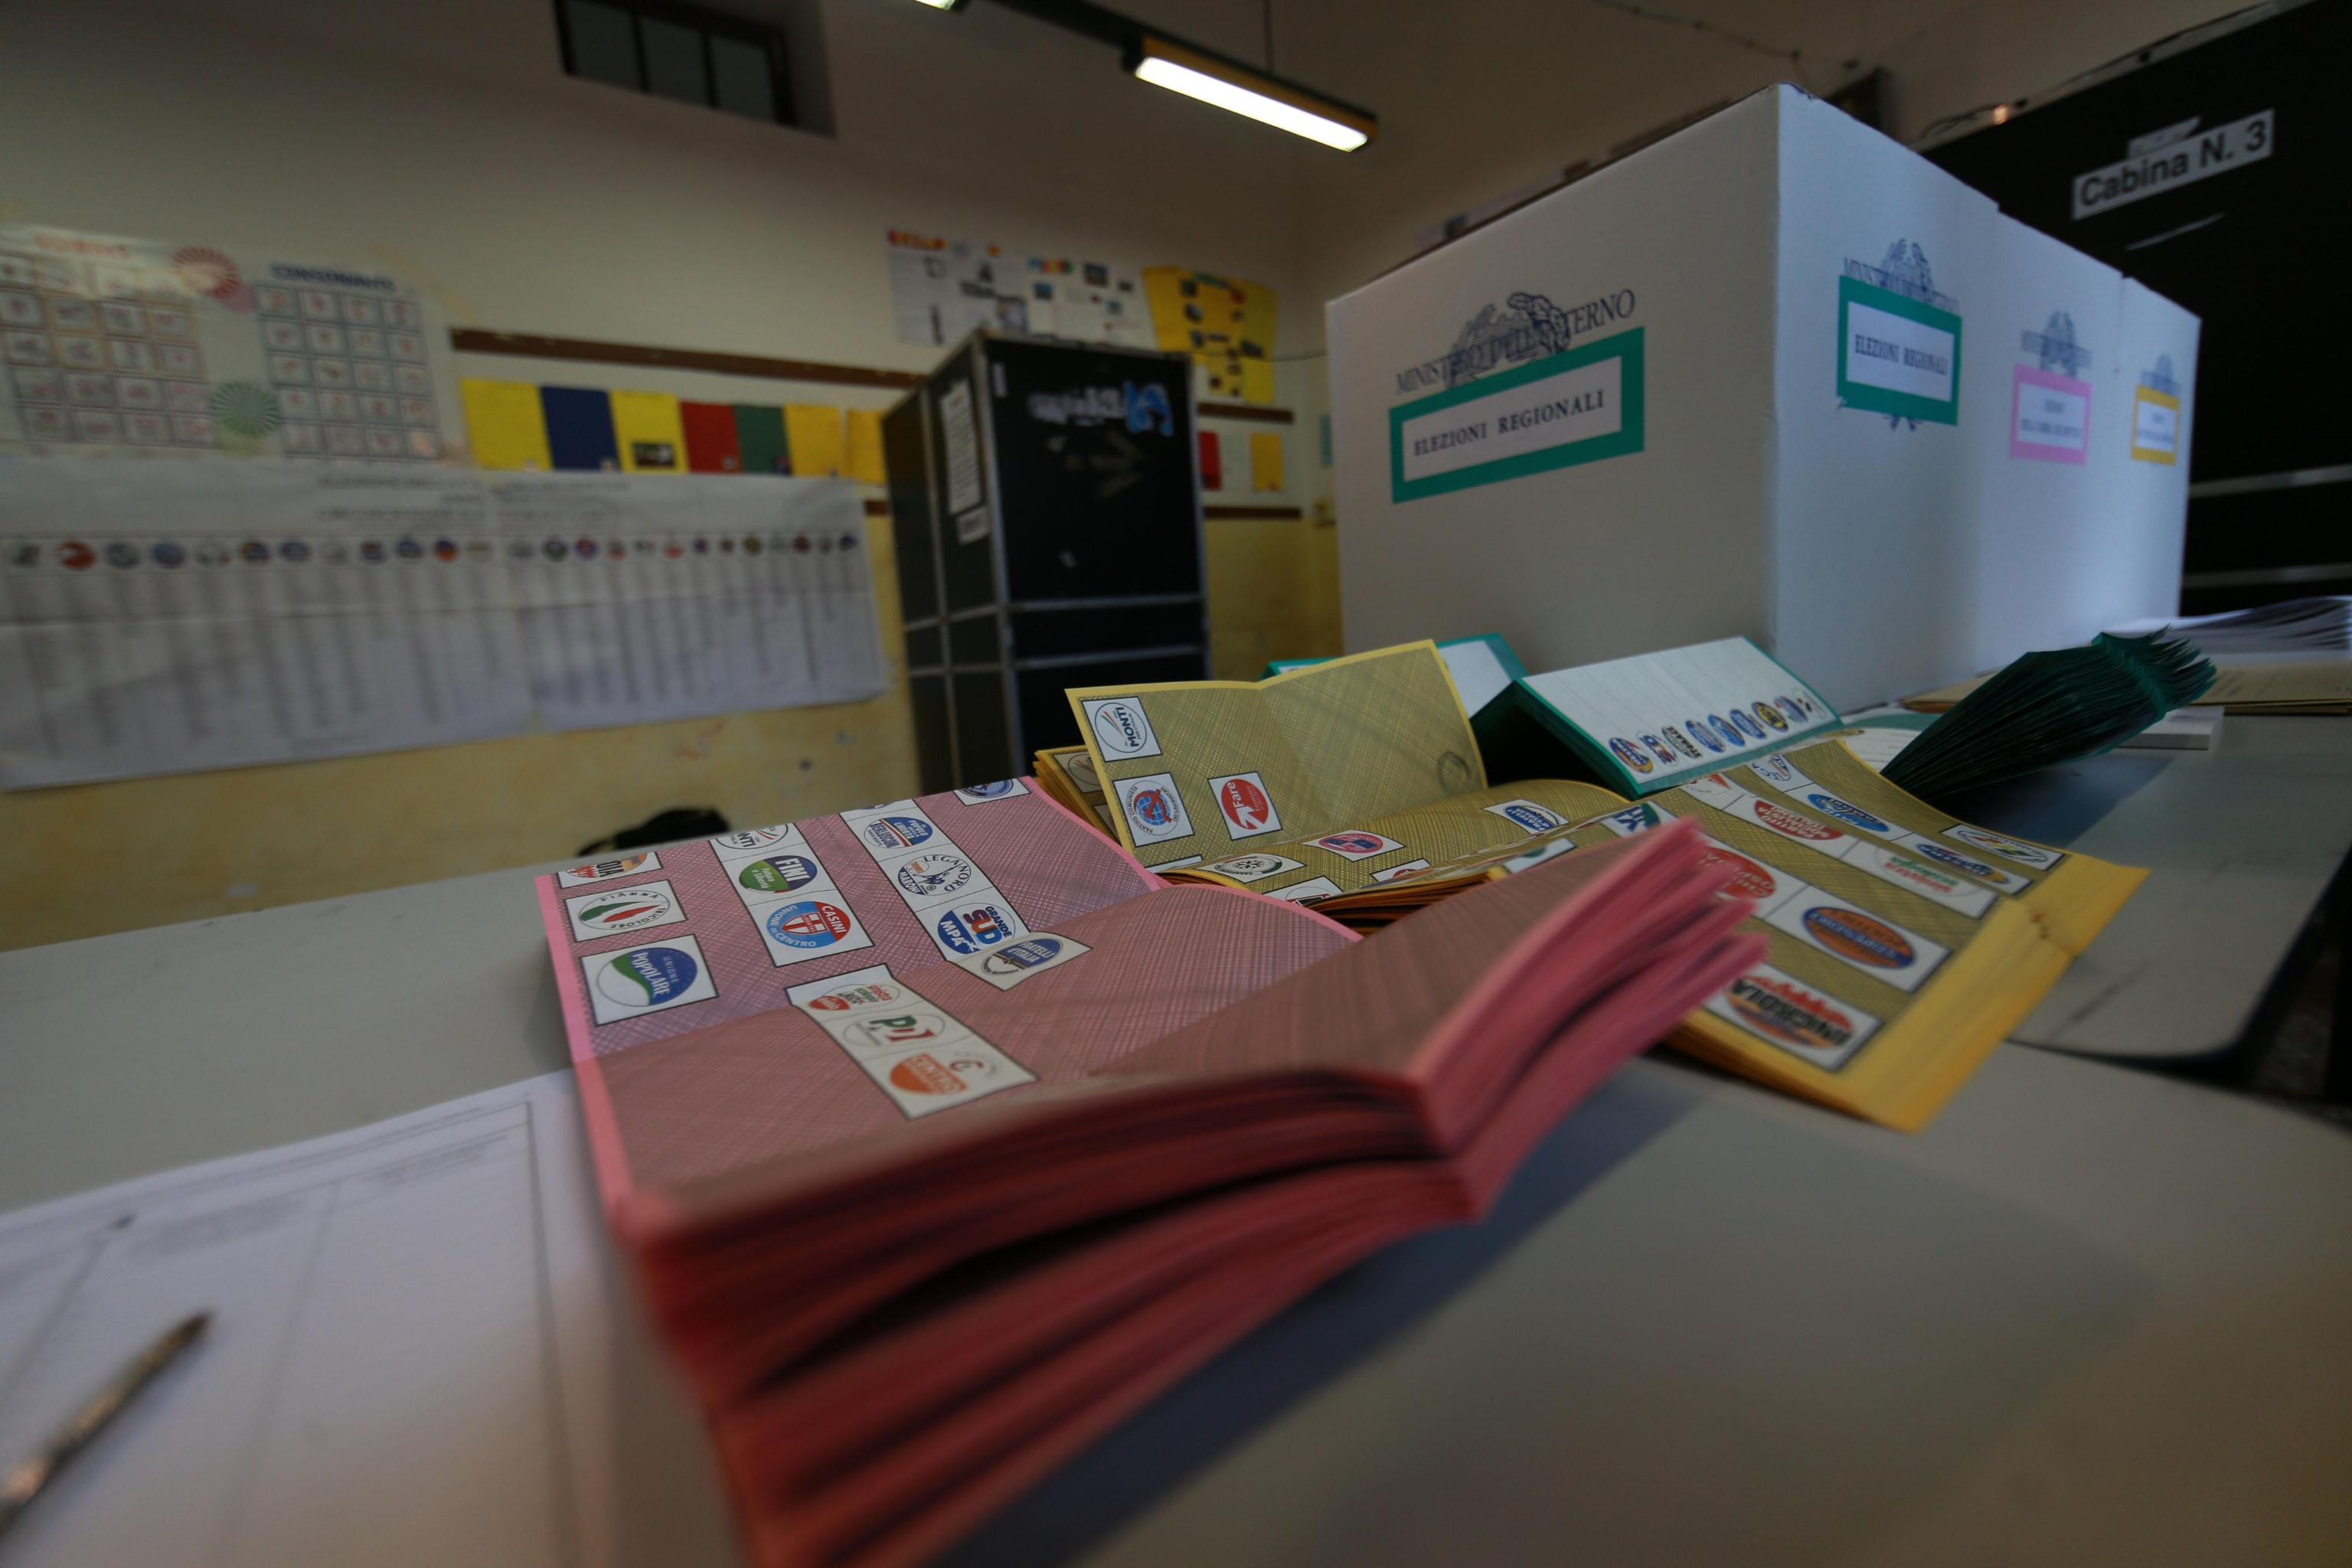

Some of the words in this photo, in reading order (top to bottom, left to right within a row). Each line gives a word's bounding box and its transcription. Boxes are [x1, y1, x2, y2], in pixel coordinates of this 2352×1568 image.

[2079, 152, 2189, 207] Cabina
[2199, 132, 2234, 168] N.
[2246, 119, 2266, 152] 3
[1854, 334, 1900, 363] ELEZIONI
[1414, 421, 1487, 456] ELEZIONI
[1498, 390, 1604, 436] REGIONALI
[1115, 707, 1139, 747] MONTI
[1227, 782, 1244, 808] Fare
[775, 858, 810, 882] FINI
[900, 871, 920, 893] MARONI
[923, 854, 959, 865] LEGA
[944, 864, 970, 892] NORD
[600, 890, 659, 902] FIAMMA
[610, 906, 666, 929] TRICOLORE
[769, 905, 799, 927] UNIONE
[822, 906, 847, 933] CASINI
[962, 909, 1002, 945] SUD
[985, 906, 1013, 938] GRANDE
[774, 933, 817, 947] CENTRO
[940, 920, 965, 946] MPA
[1018, 941, 1056, 959] FRATELLI
[631, 952, 671, 997] POPOLARE
[663, 956, 679, 983] UNIONE
